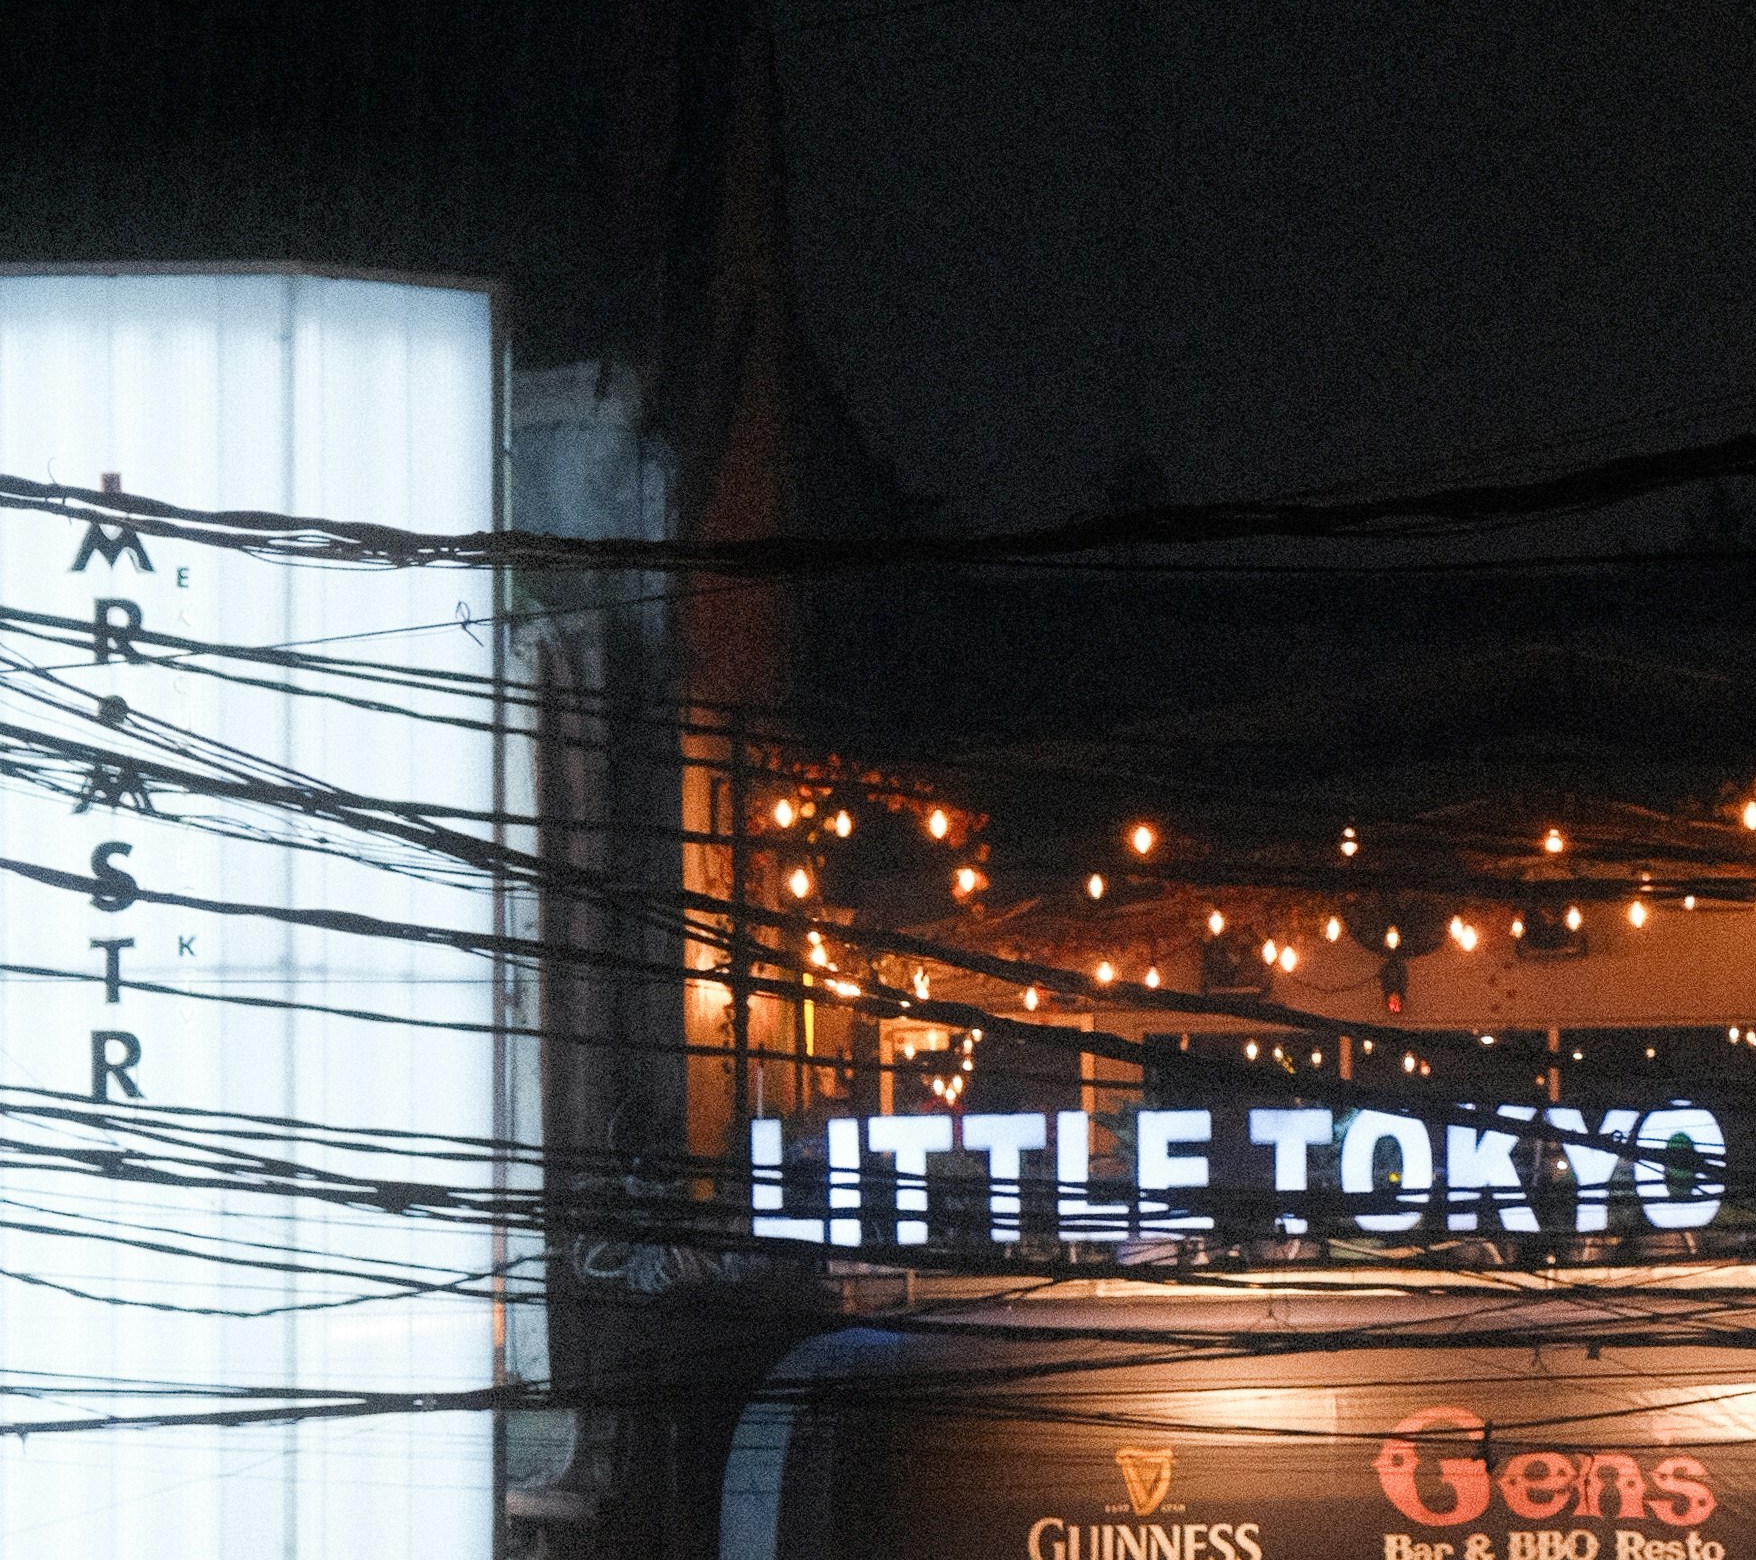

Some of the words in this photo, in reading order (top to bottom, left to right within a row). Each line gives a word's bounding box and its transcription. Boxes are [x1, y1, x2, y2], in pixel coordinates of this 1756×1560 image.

[750, 1109, 1215, 1247] LITTLE
[1248, 1099, 1727, 1234] TOKYO
[1370, 1405, 1718, 1527] Gens
